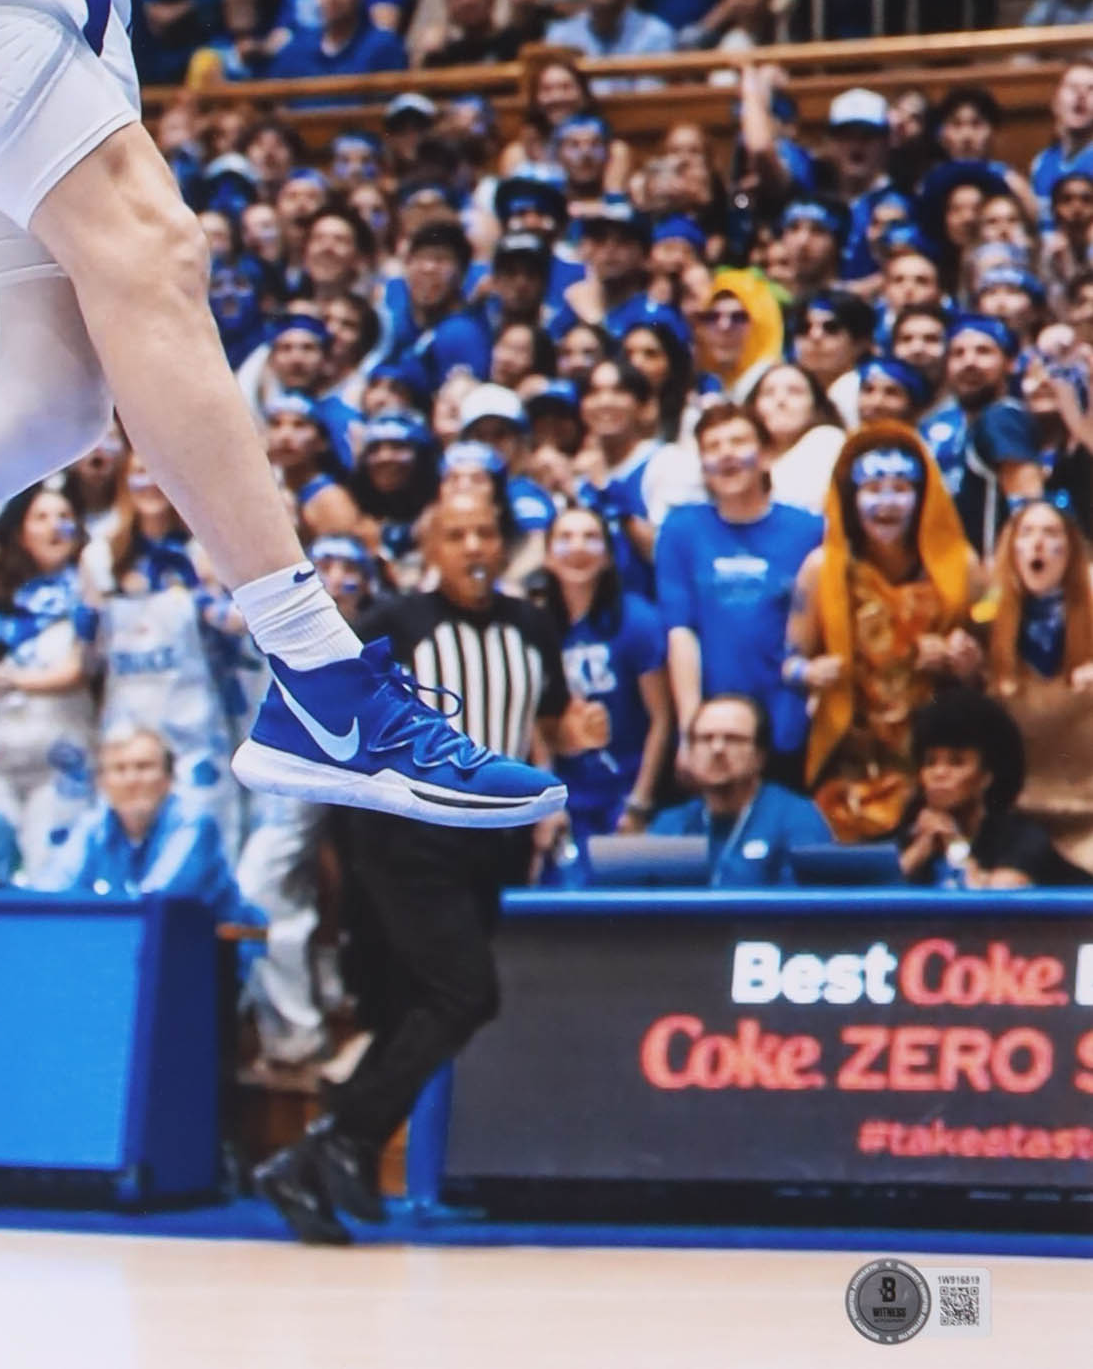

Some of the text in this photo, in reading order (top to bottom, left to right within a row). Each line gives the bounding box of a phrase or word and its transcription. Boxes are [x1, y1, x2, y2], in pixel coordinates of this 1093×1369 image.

[732, 941, 897, 1005] Best
[900, 937, 1070, 1006] Coke
[640, 1013, 826, 1091] Coke
[837, 1024, 1055, 1094] ZERO
